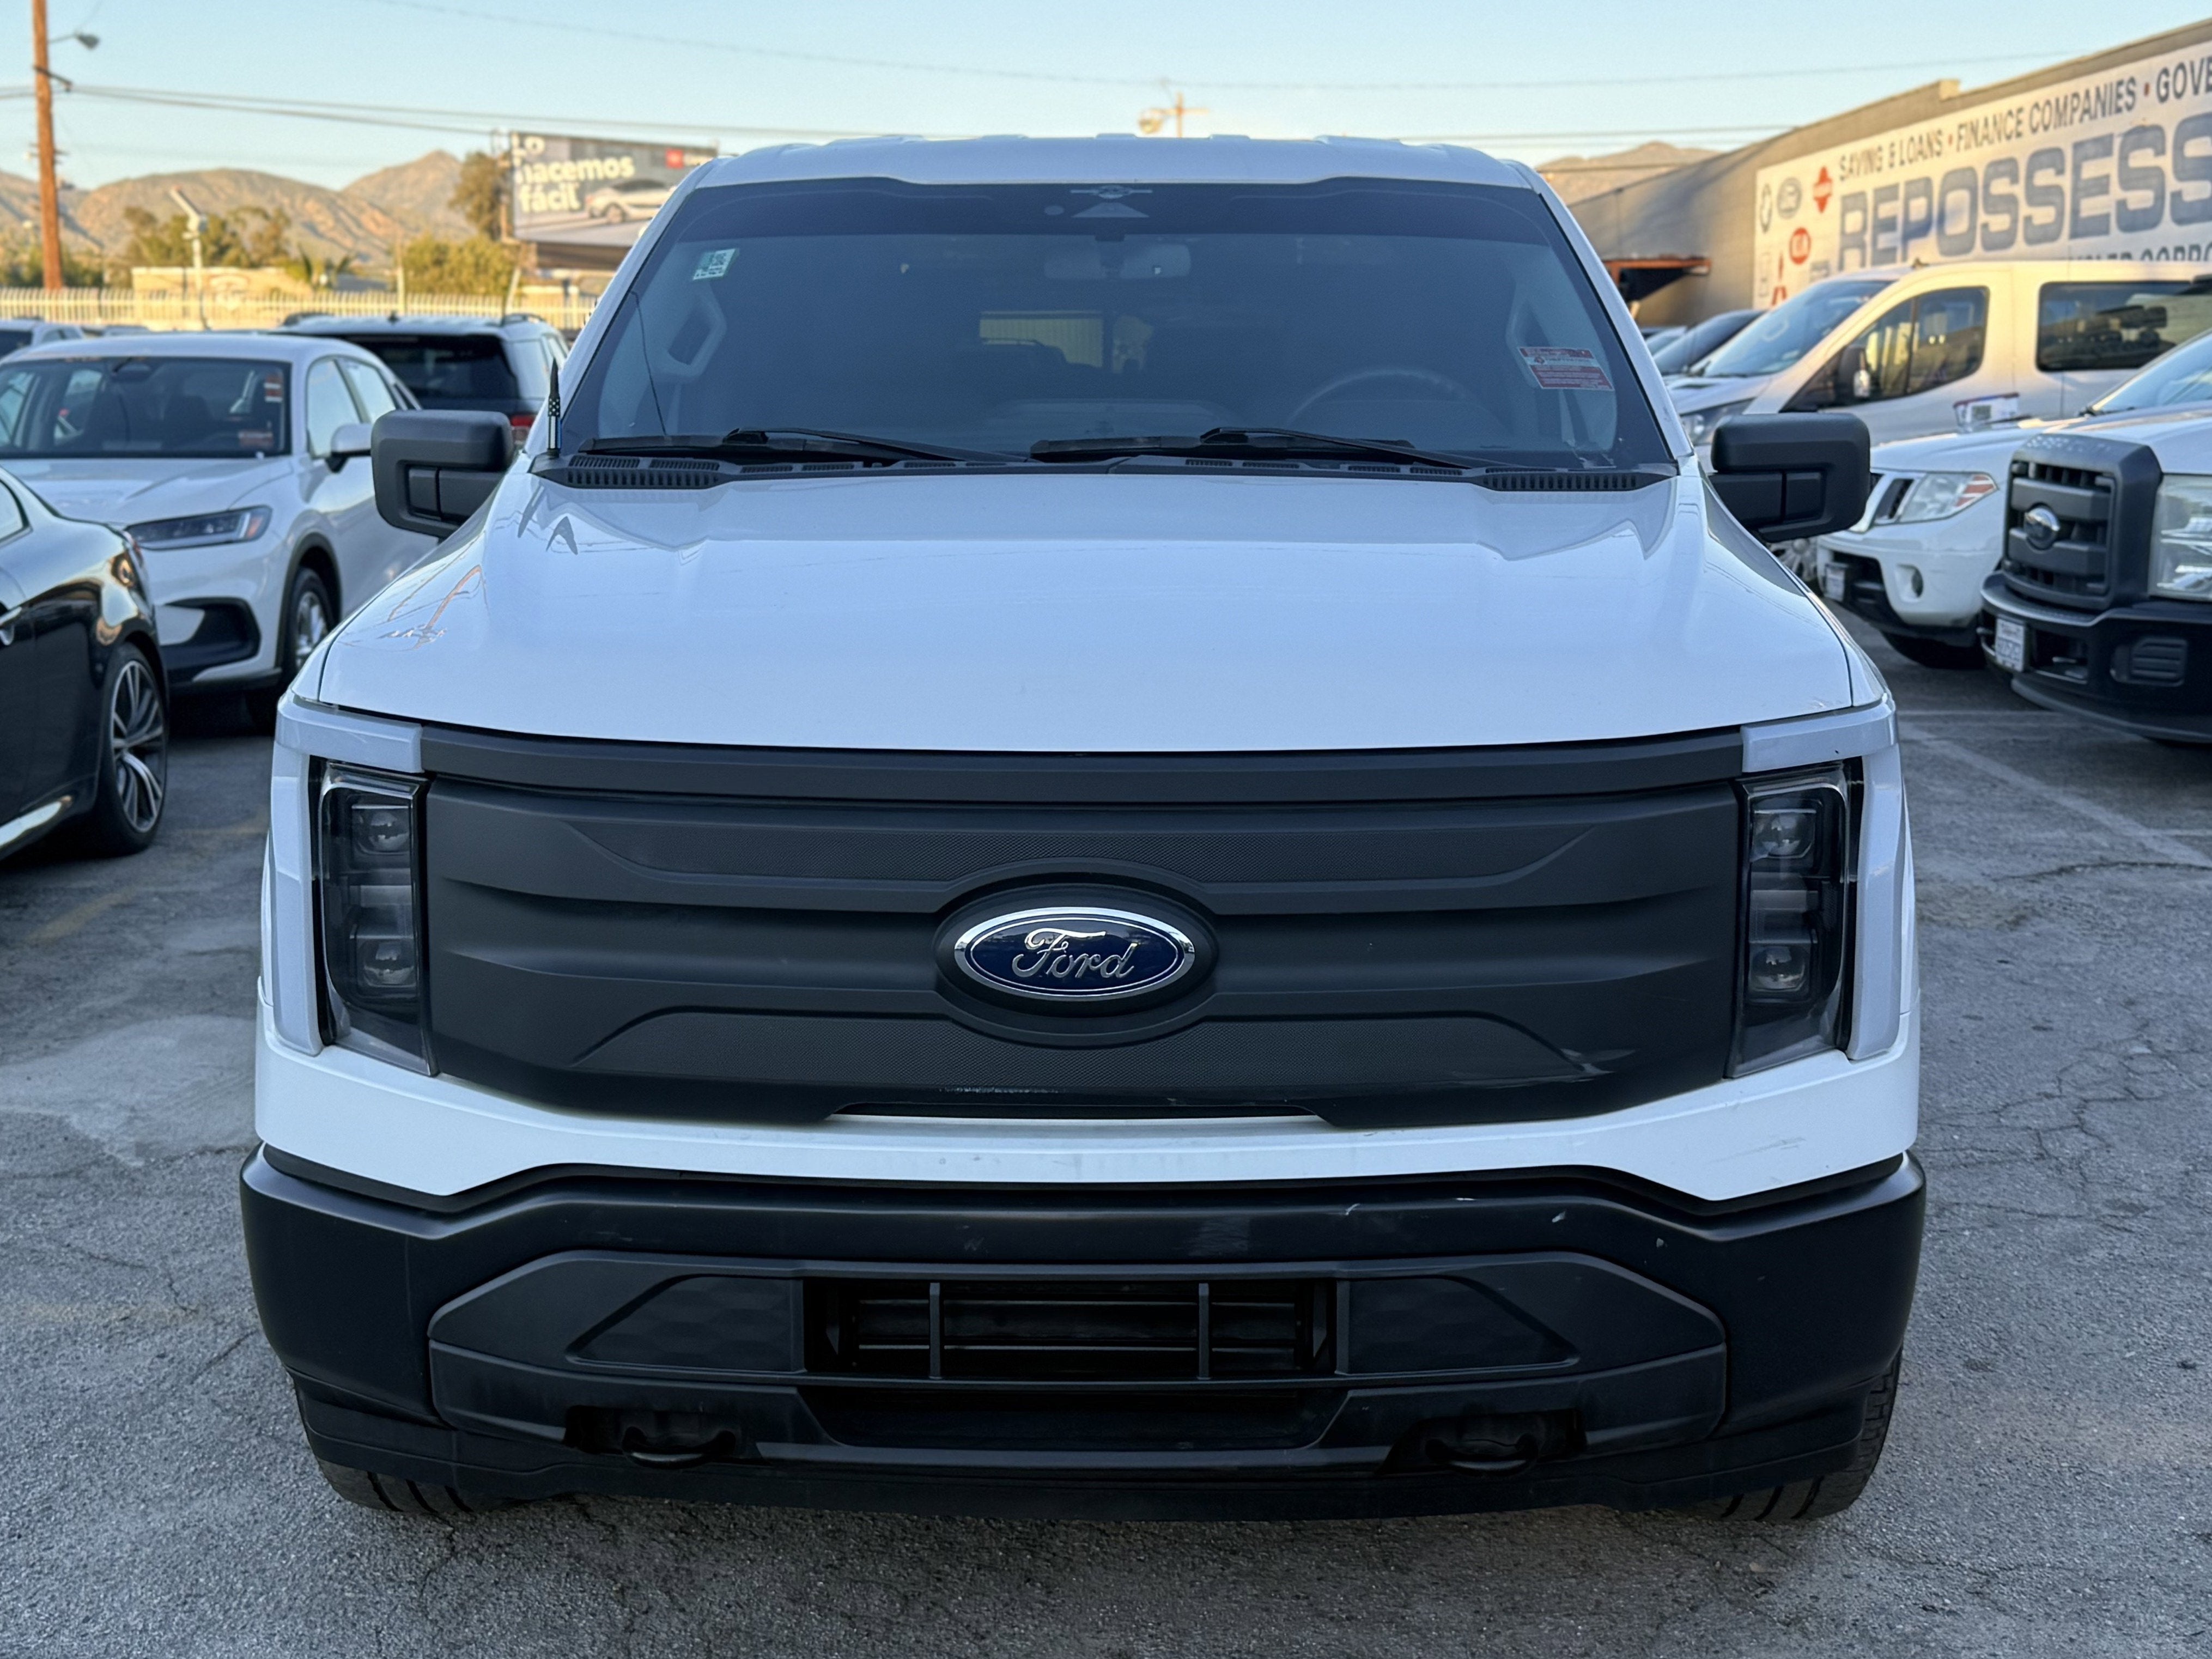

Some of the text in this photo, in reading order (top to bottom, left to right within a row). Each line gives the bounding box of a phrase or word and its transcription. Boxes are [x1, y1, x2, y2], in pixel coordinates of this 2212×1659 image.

[1839, 145, 1883, 181] SAVING
[1900, 129, 1943, 166] LOANS
[1956, 107, 2024, 153] FINANCE
[2029, 76, 2136, 134] COMPANIES
[1012, 927, 1138, 979] Ford
